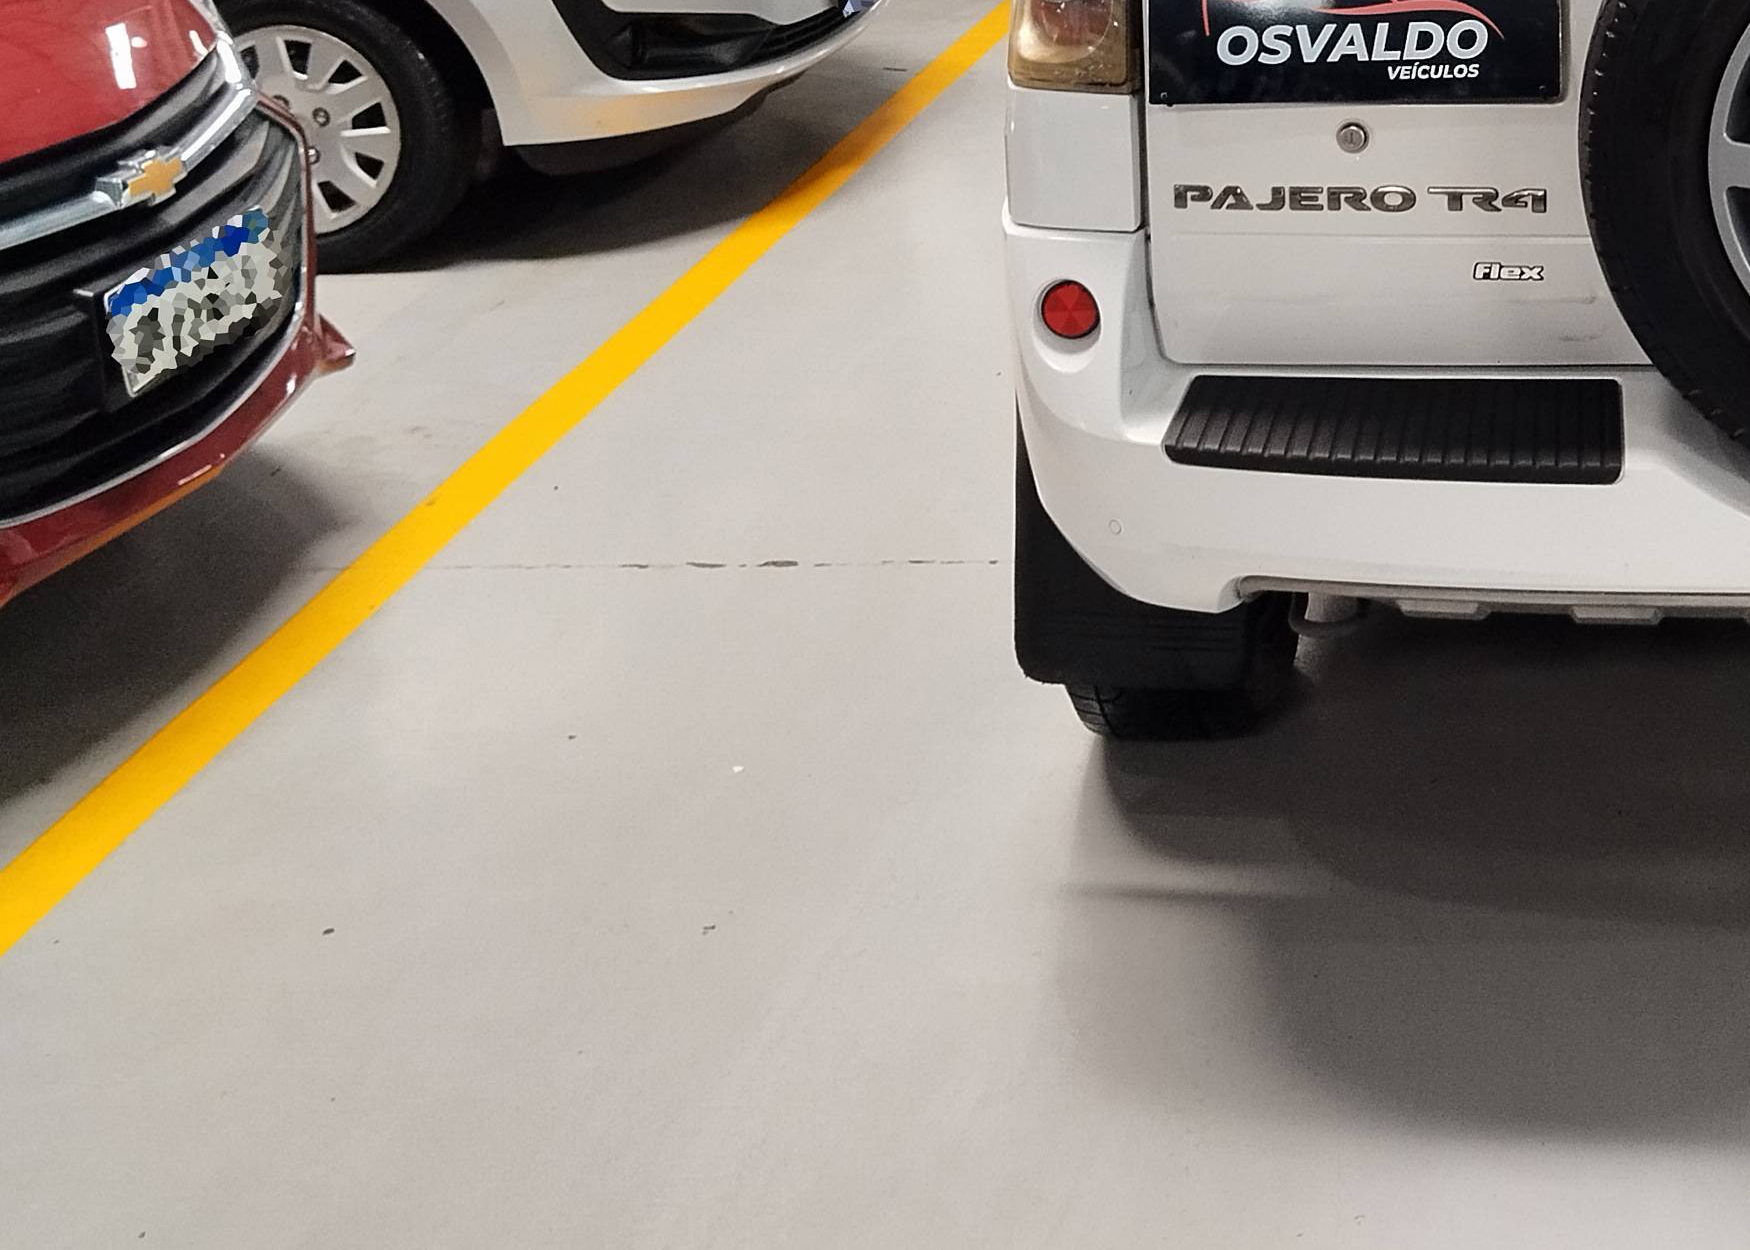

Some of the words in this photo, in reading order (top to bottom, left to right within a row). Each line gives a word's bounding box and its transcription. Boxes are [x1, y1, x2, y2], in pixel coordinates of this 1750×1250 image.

[1215, 19, 1489, 67] OSVALDO
[1387, 62, 1480, 81] VEÍCULOS
[1173, 184, 1417, 213] PAJERO
[1427, 185, 1547, 214] TR4
